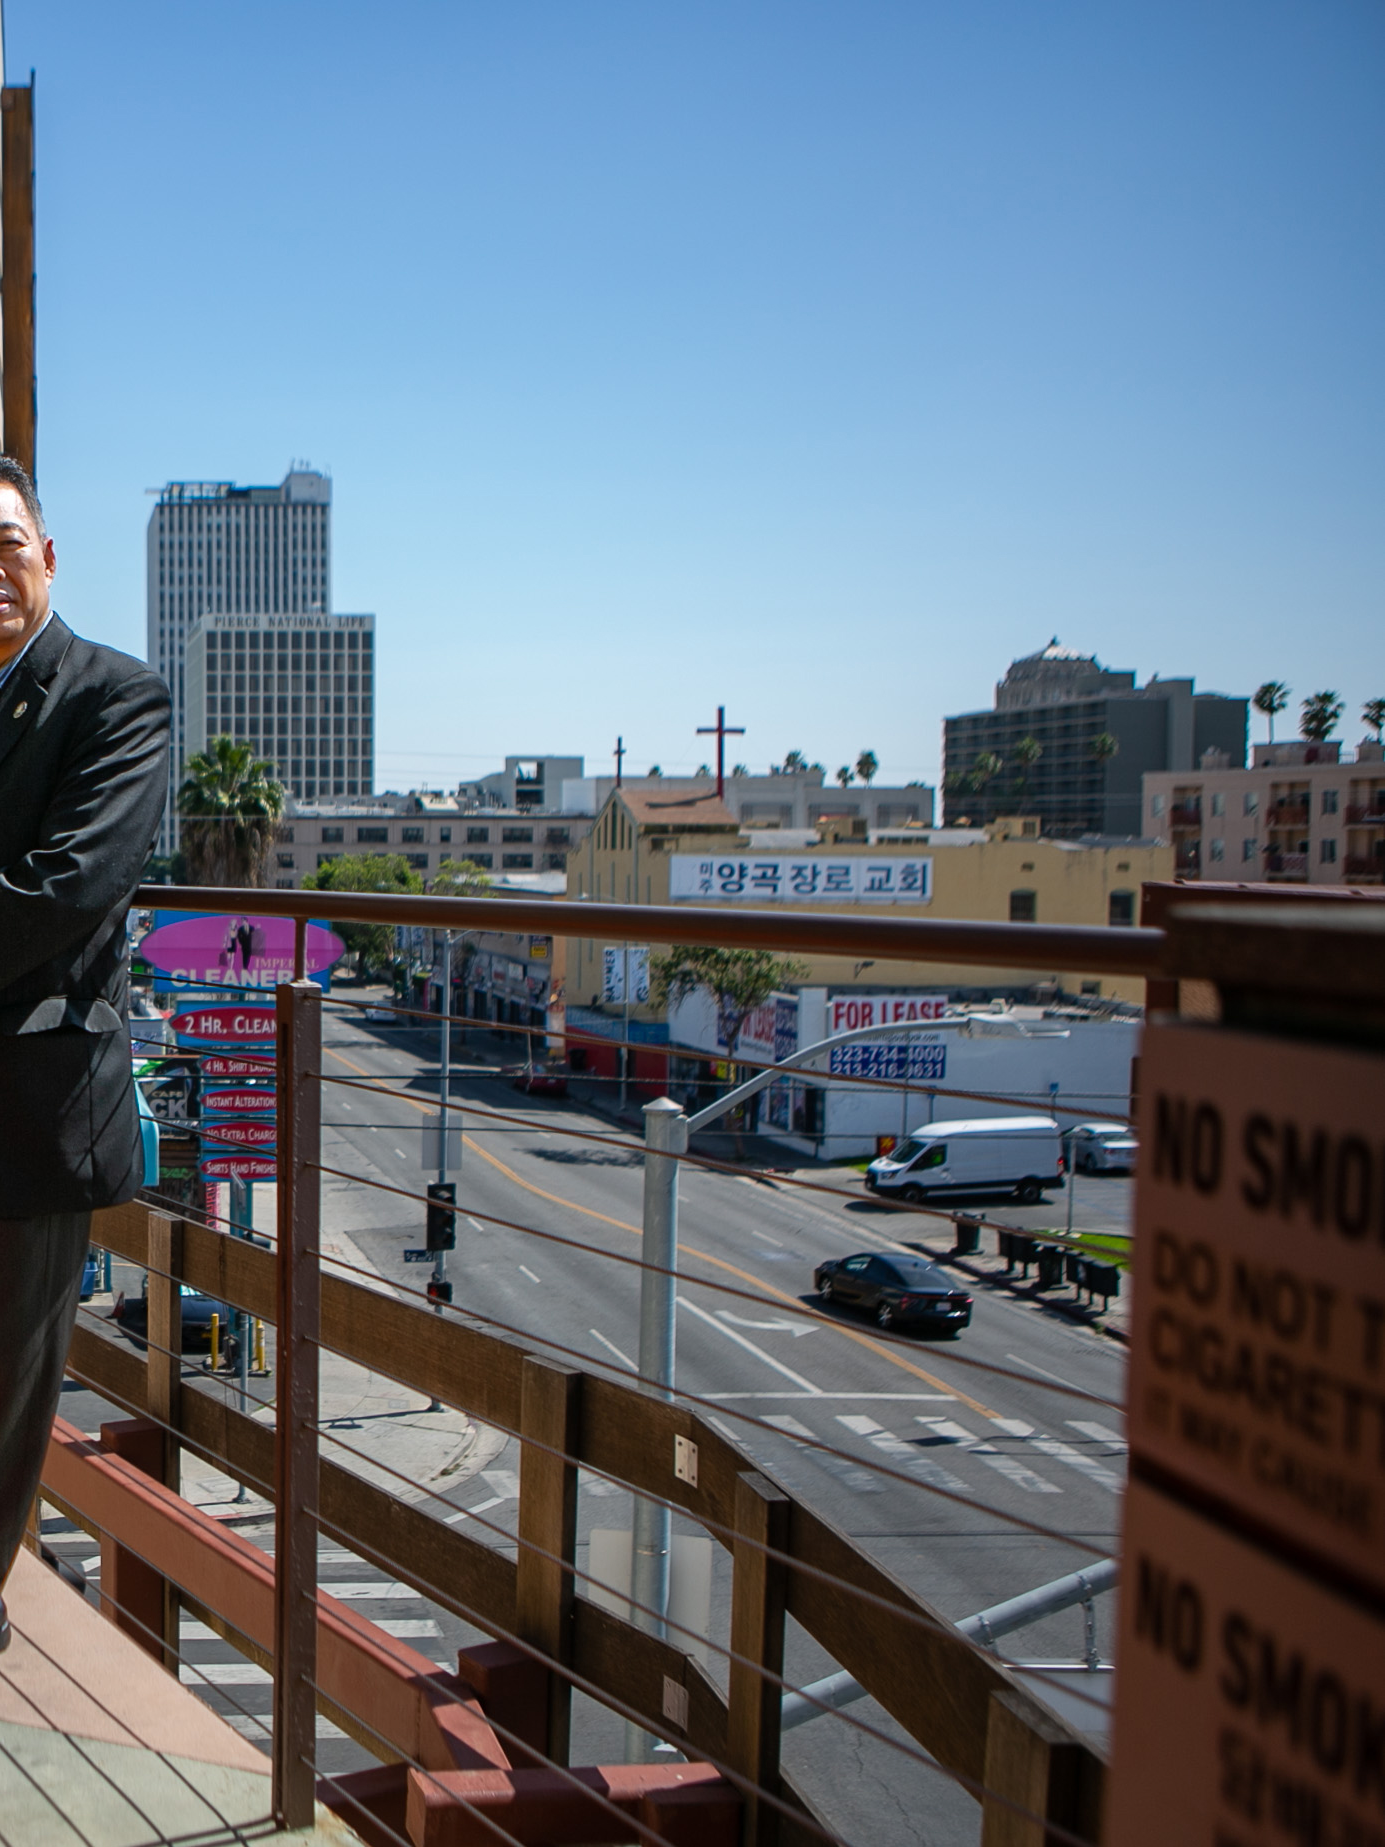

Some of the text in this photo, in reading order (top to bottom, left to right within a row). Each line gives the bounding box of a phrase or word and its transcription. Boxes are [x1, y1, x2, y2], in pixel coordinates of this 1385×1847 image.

[215, 616, 366, 628] PIERCE NATIONAL LIFE
[255, 957, 320, 969] IMPERL
[170, 969, 309, 988] CLEANER
[833, 1001, 873, 1030] FOR
[185, 1016, 195, 1034] 2
[228, 1061, 248, 1072] SHIRT
[206, 1095, 233, 1107] INSTANT
[221, 1128, 246, 1140] EXTRA
[248, 1128, 277, 1141] CHARG
[206, 1162, 229, 1174] SHIRTS
[230, 1162, 249, 1174] HAND
[1152, 1091, 1385, 1252] NO SMO
[1152, 1228, 1220, 1306] DO
[1231, 1257, 1337, 1353] NOT
[1134, 1551, 1204, 1673] NO
